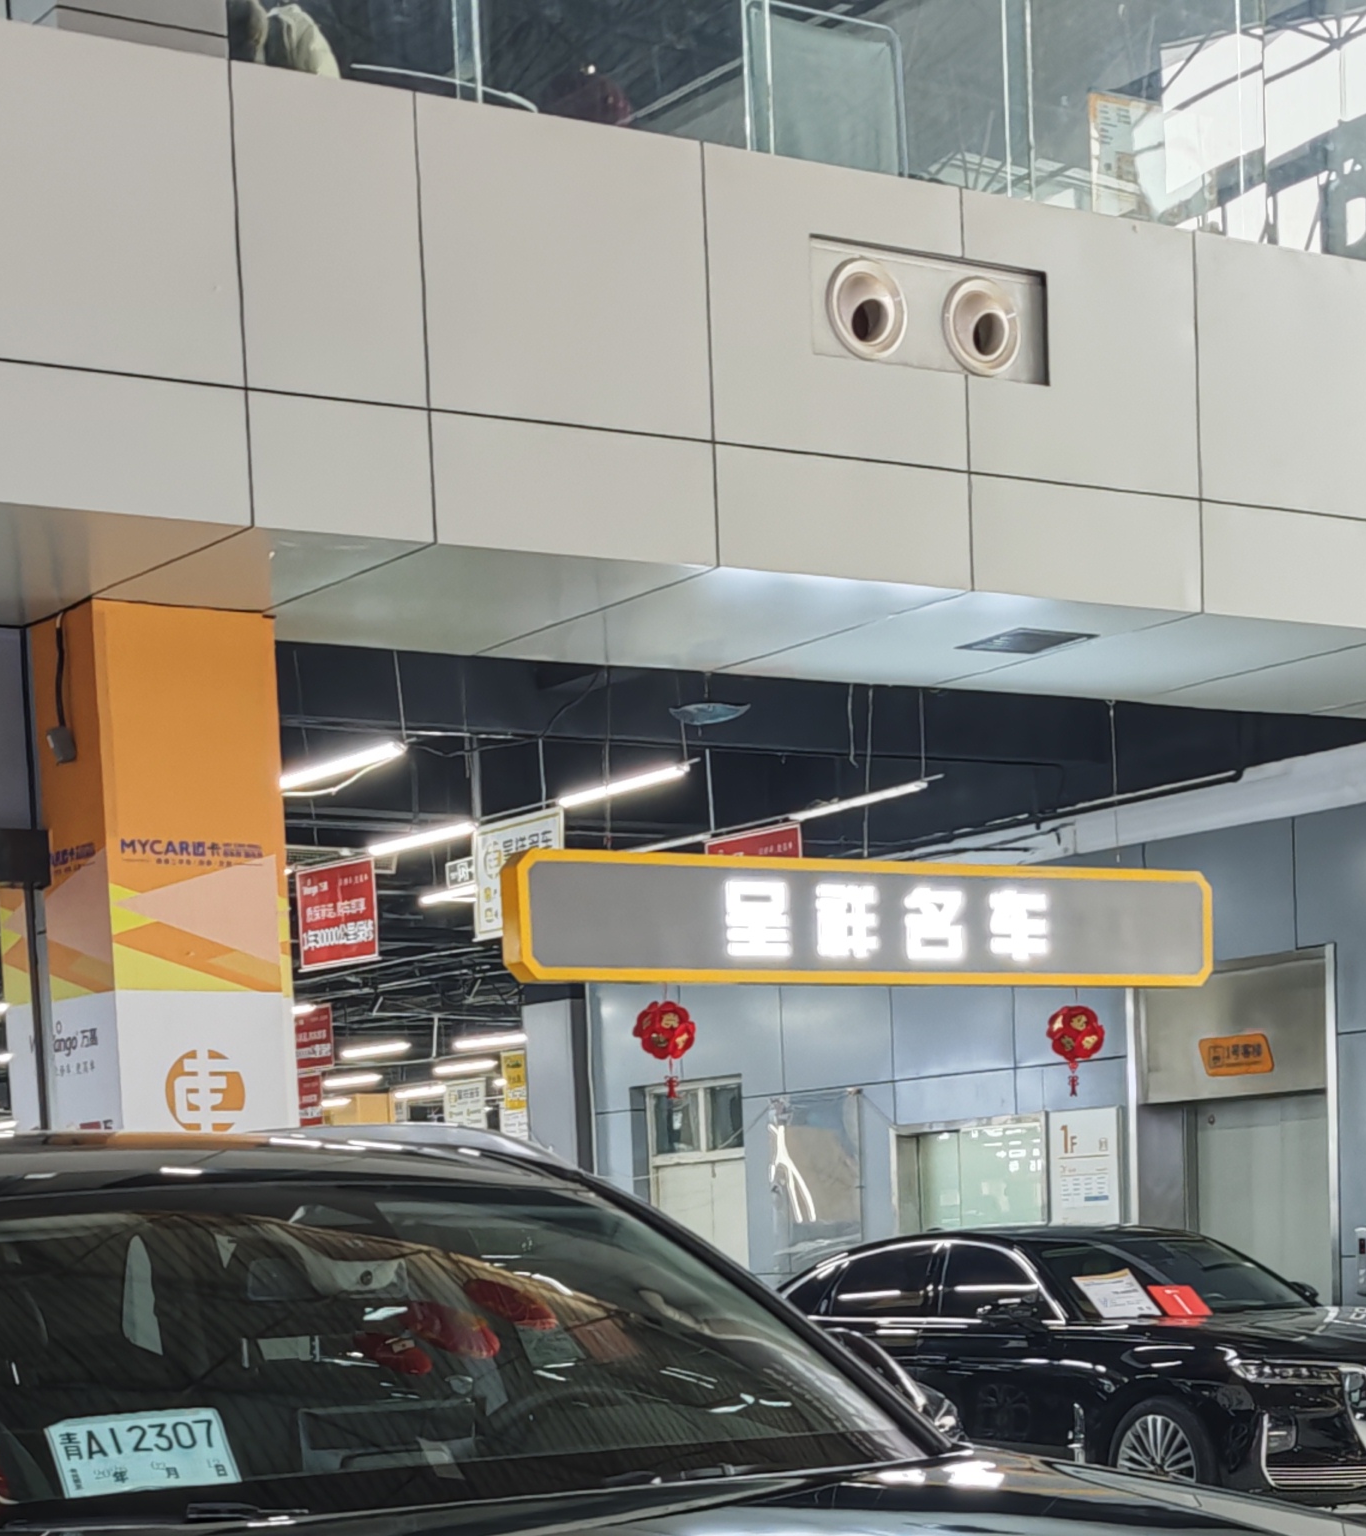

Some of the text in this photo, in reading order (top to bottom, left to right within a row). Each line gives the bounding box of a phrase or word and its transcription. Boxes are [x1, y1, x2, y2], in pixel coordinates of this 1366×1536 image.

[120, 838, 190, 857] MYCAR
[724, 877, 1052, 963] 呈祥名车
[58, 1418, 214, 1462] 青A12307
